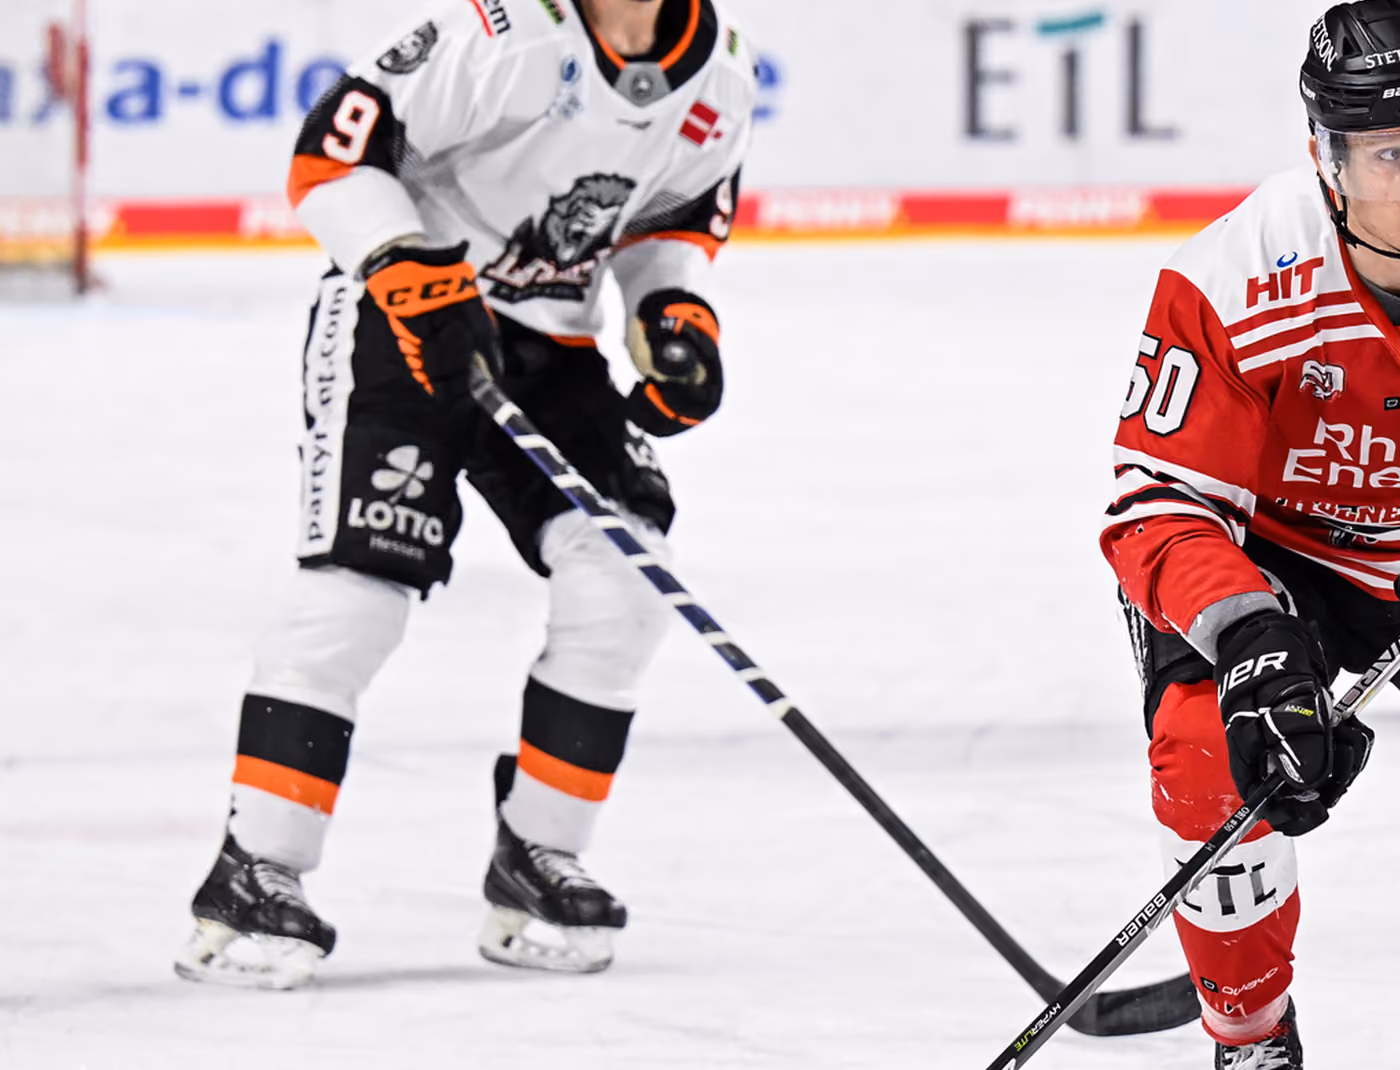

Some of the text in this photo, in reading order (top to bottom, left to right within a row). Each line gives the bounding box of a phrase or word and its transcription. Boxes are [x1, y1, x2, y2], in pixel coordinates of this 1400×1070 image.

[962, 12, 1183, 141] ETL
[321, 89, 380, 165] 9
[1246, 252, 1324, 309] HIT
[307, 287, 347, 542] partyrnt.com
[1119, 331, 1202, 438] 50
[348, 497, 444, 546] LOTTO
[1218, 651, 1289, 702] UER
[1174, 857, 1277, 917] TL
[1013, 1002, 1062, 1052] HYPERLITE
